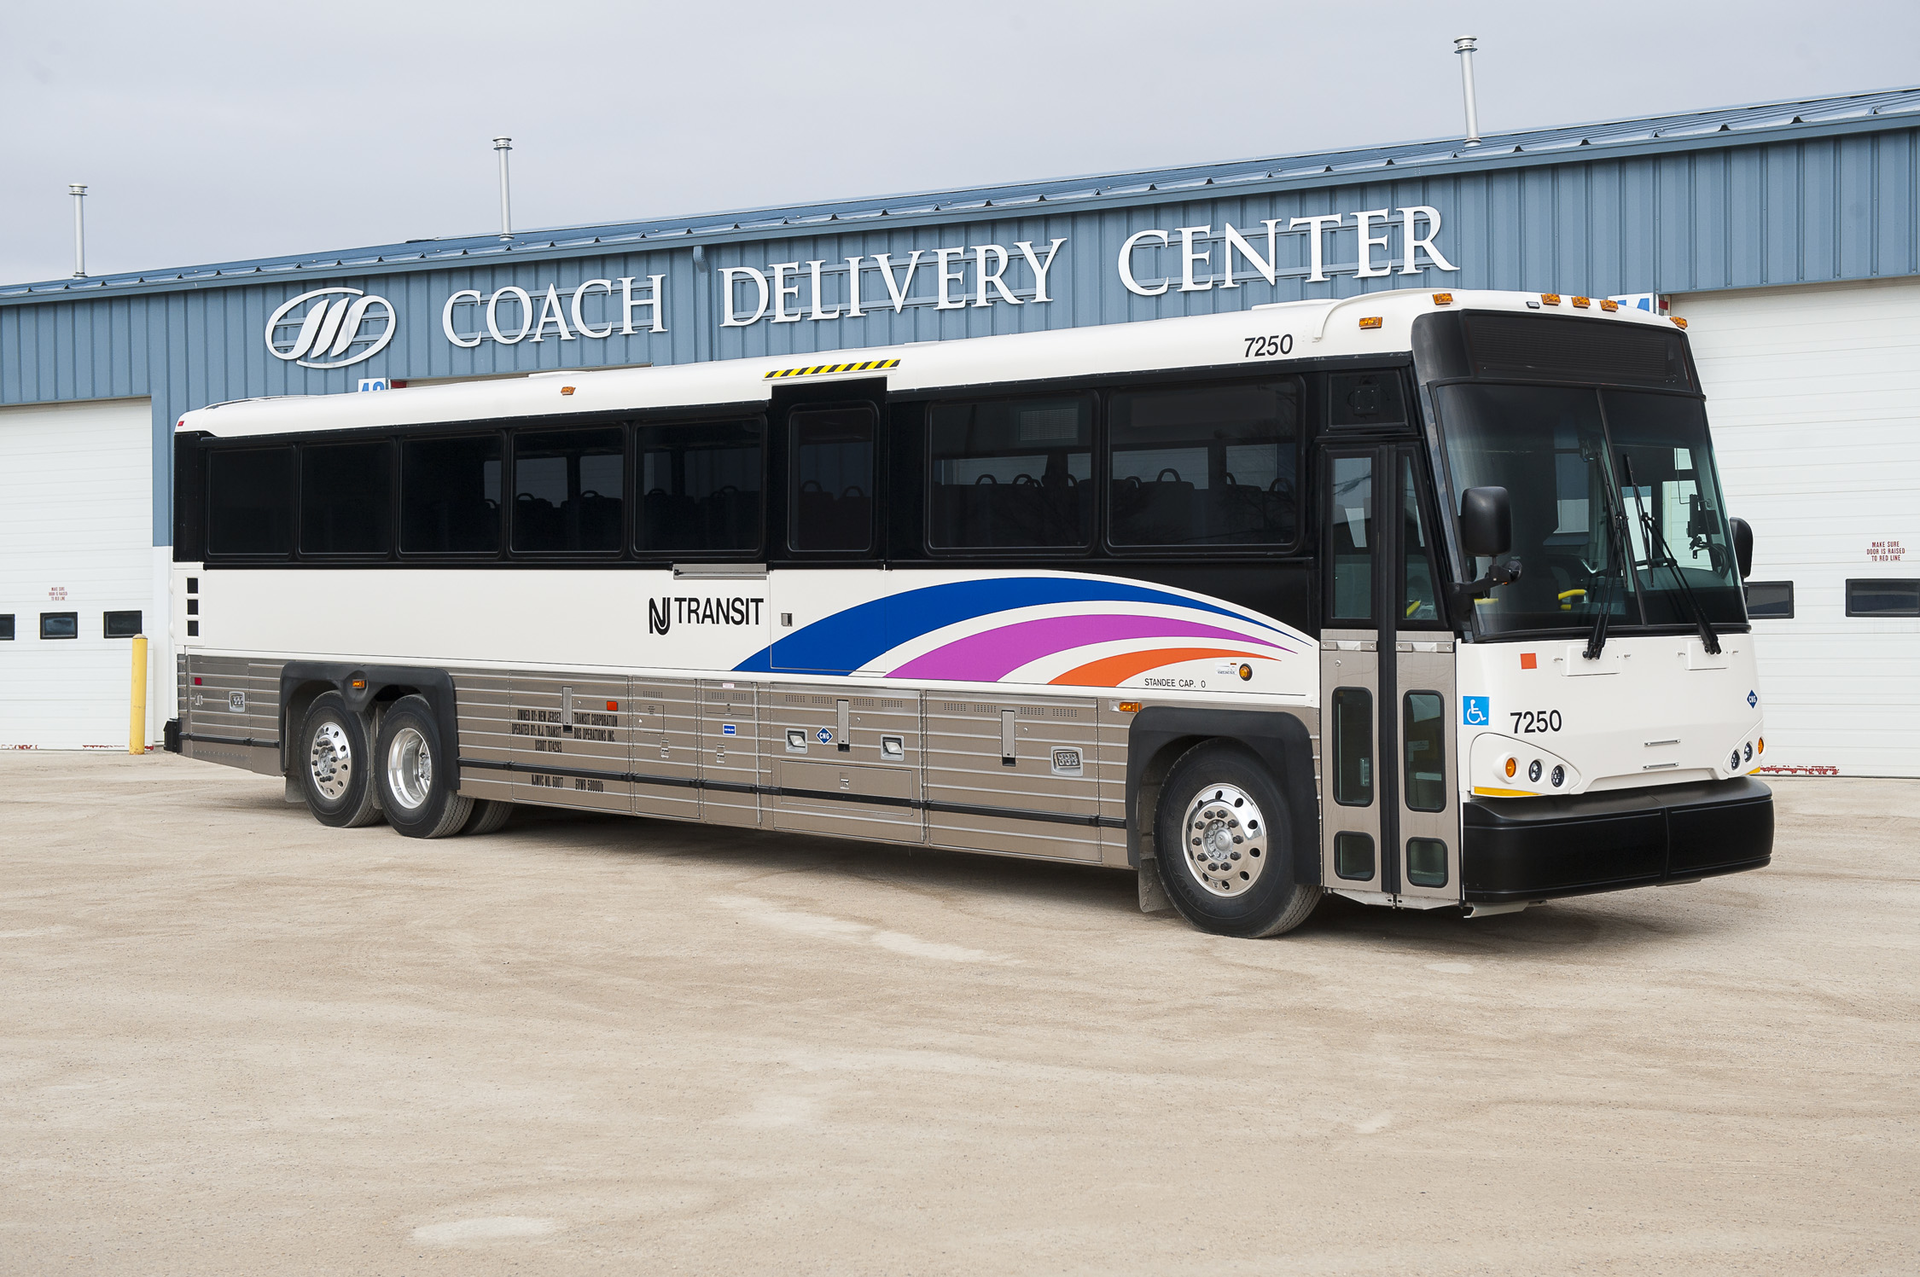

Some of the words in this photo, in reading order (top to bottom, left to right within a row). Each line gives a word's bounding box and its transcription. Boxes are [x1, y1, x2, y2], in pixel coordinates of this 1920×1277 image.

[441, 273, 668, 348] COACH
[717, 236, 1068, 328] DELIVERY
[1115, 205, 1461, 297] CENTER
[1243, 333, 1294, 358] 7250
[649, 597, 671, 636] NJ
[674, 597, 764, 626] TRANSIT
[1144, 678, 1176, 687] STANDEE
[1179, 679, 1196, 688] CAP.
[1748, 695, 1757, 703] CNG
[517, 709, 530, 721] OWNED
[538, 711, 546, 722] NEW
[547, 711, 561, 723] JERSEY
[574, 712, 590, 725] TRANSIT
[591, 713, 618, 727] CORPORATION
[1509, 709, 1562, 734] 7250
[512, 723, 529, 735] OPERATED
[546, 726, 561, 738] TRANSIT
[583, 728, 606, 741] OPERATIONS
[819, 732, 830, 740] CNG
